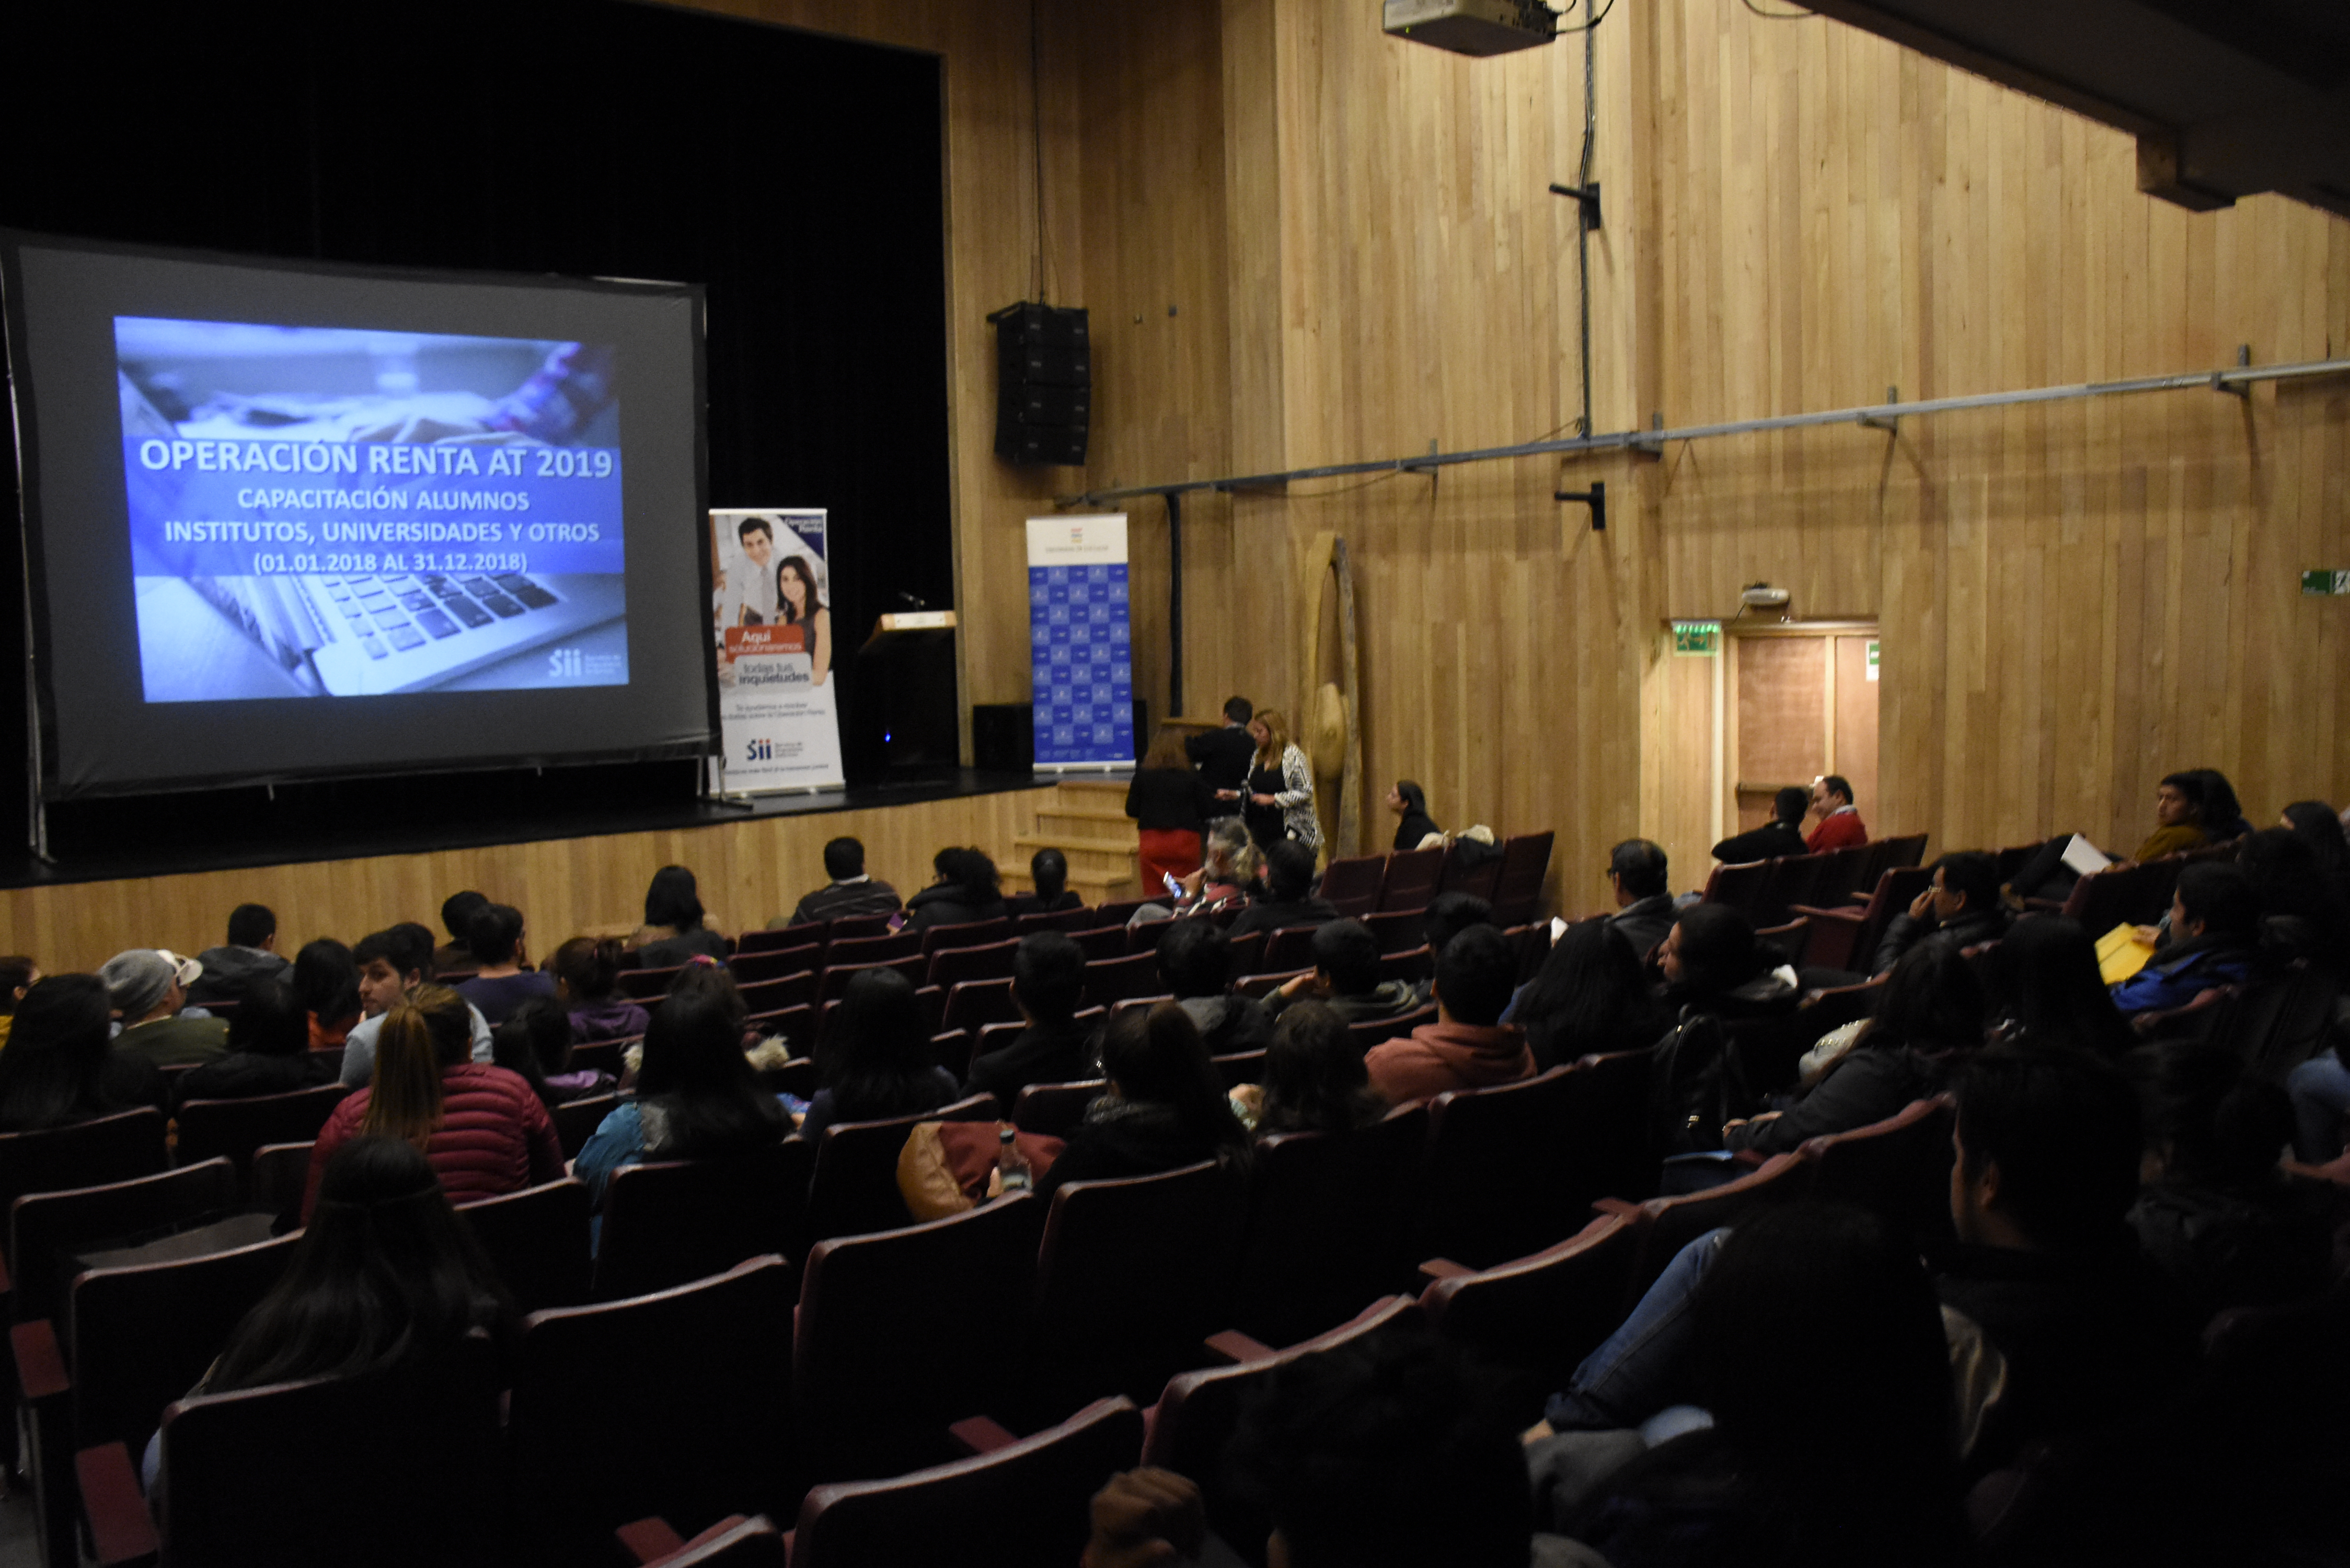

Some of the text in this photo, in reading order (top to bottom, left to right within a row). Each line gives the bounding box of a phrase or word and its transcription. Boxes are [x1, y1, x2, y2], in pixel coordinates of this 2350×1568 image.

[140, 438, 613, 479] OPERACIÓN RENTA AT 2019
[237, 485, 531, 511] CAPACITACIÓN ALUMNOS
[165, 521, 601, 546] INSTITUTOS, UNIVERSIDADES Y OTROS
[254, 552, 528, 576] (01.01.2018 AL 31.12.2018)
